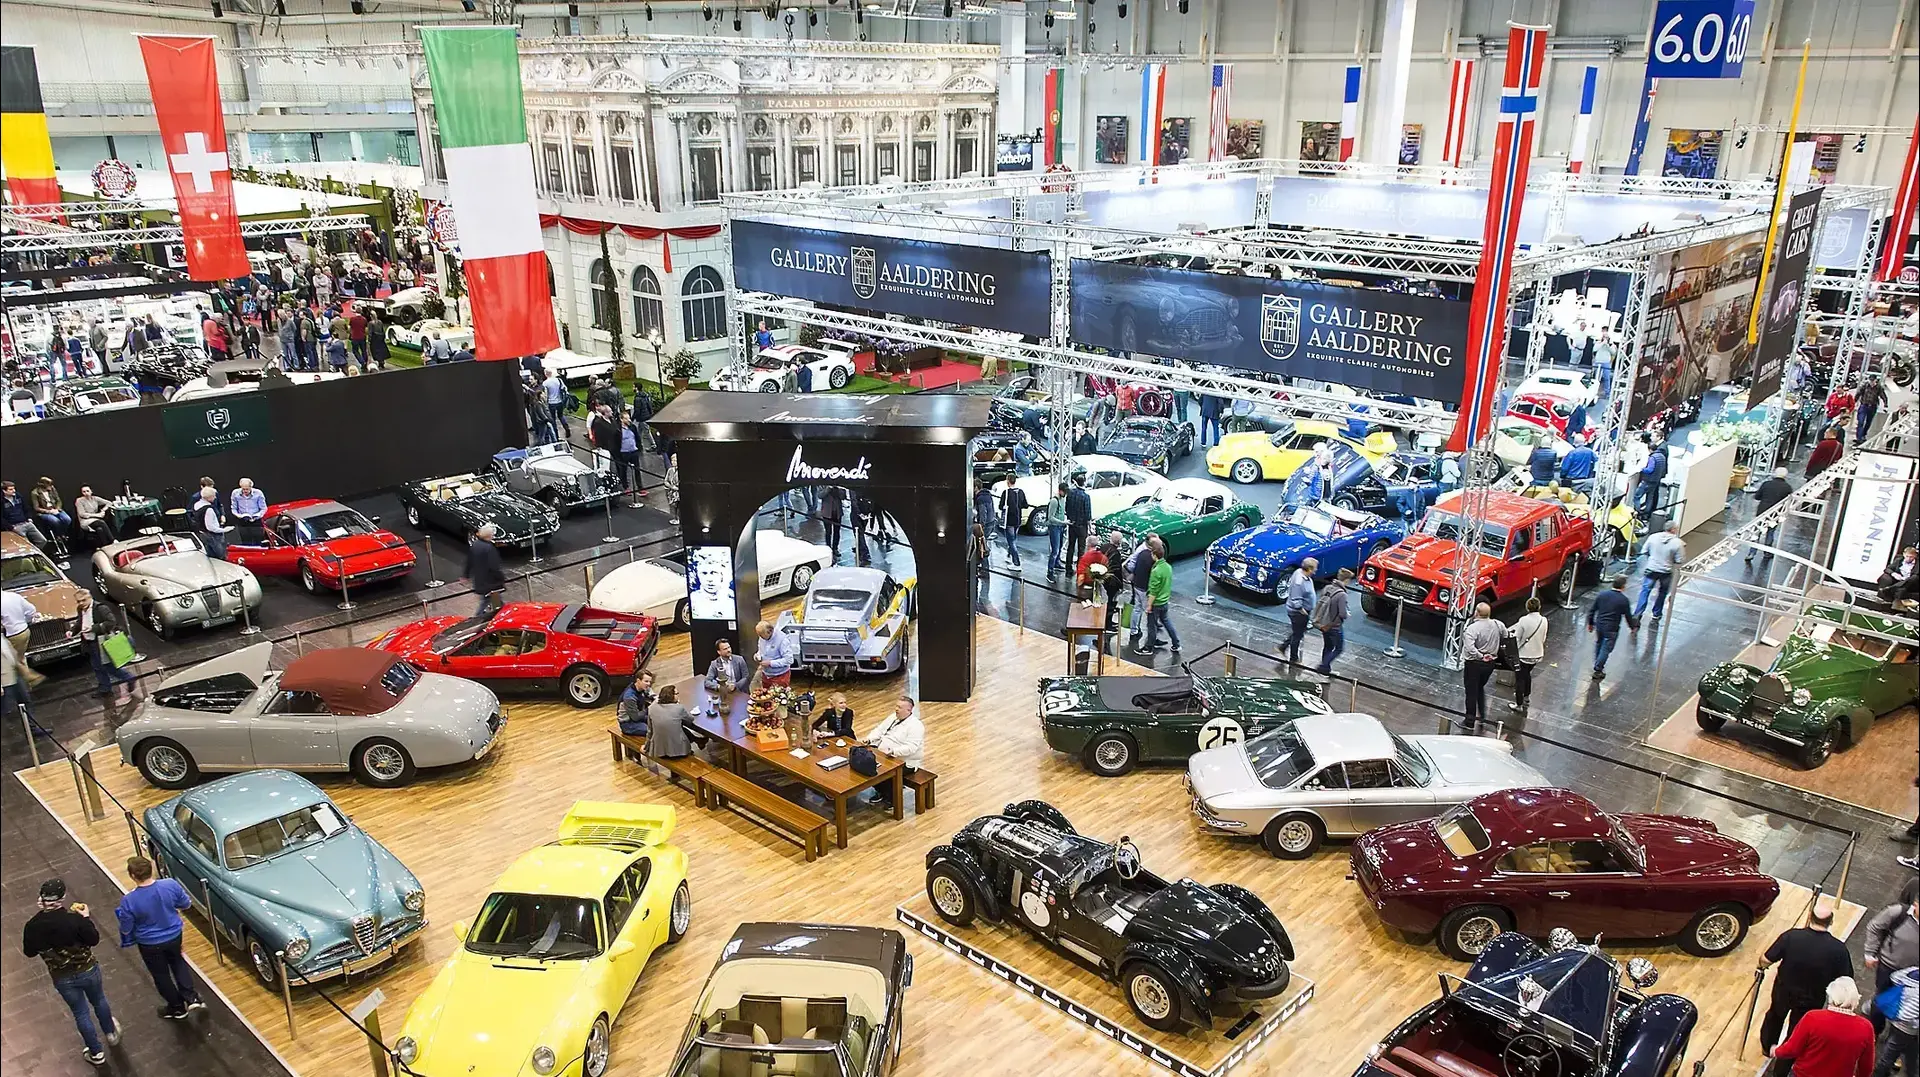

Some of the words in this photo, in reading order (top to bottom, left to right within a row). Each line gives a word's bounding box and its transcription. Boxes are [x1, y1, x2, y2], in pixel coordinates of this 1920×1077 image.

[1654, 13, 1724, 63] 6.0
[1725, 13, 1750, 64] 6.0
[524, 96, 573, 106] UTOMOBILE
[767, 99, 810, 108] PALAIS
[816, 99, 832, 108] DE
[838, 98, 918, 108] L'AUTOMOBILE
[996, 150, 1032, 165] Sotheby's
[1791, 203, 1816, 231] GREAT
[440, 231, 458, 241] ESSE
[1786, 226, 1810, 260] CARS
[770, 246, 849, 276] GALLERY
[879, 261, 996, 297] AALDERING
[880, 283, 914, 295] EXQUISITE
[916, 288, 944, 299] CLASSIC
[946, 293, 995, 306] AUTOMOBILES
[1309, 303, 1423, 337] GALLERY
[1306, 327, 1452, 367] AALDERING
[1306, 351, 1344, 364] EXQUISITE
[1347, 358, 1378, 369] CLASSIC
[1381, 364, 1435, 378] AUTOMOBILES
[785, 444, 872, 483] Movendi
[1866, 466, 1899, 541] HYMAN
[1860, 542, 1873, 564] LTD.
[1205, 726, 1238, 750] 26
[1265, 953, 1281, 971] GAY
